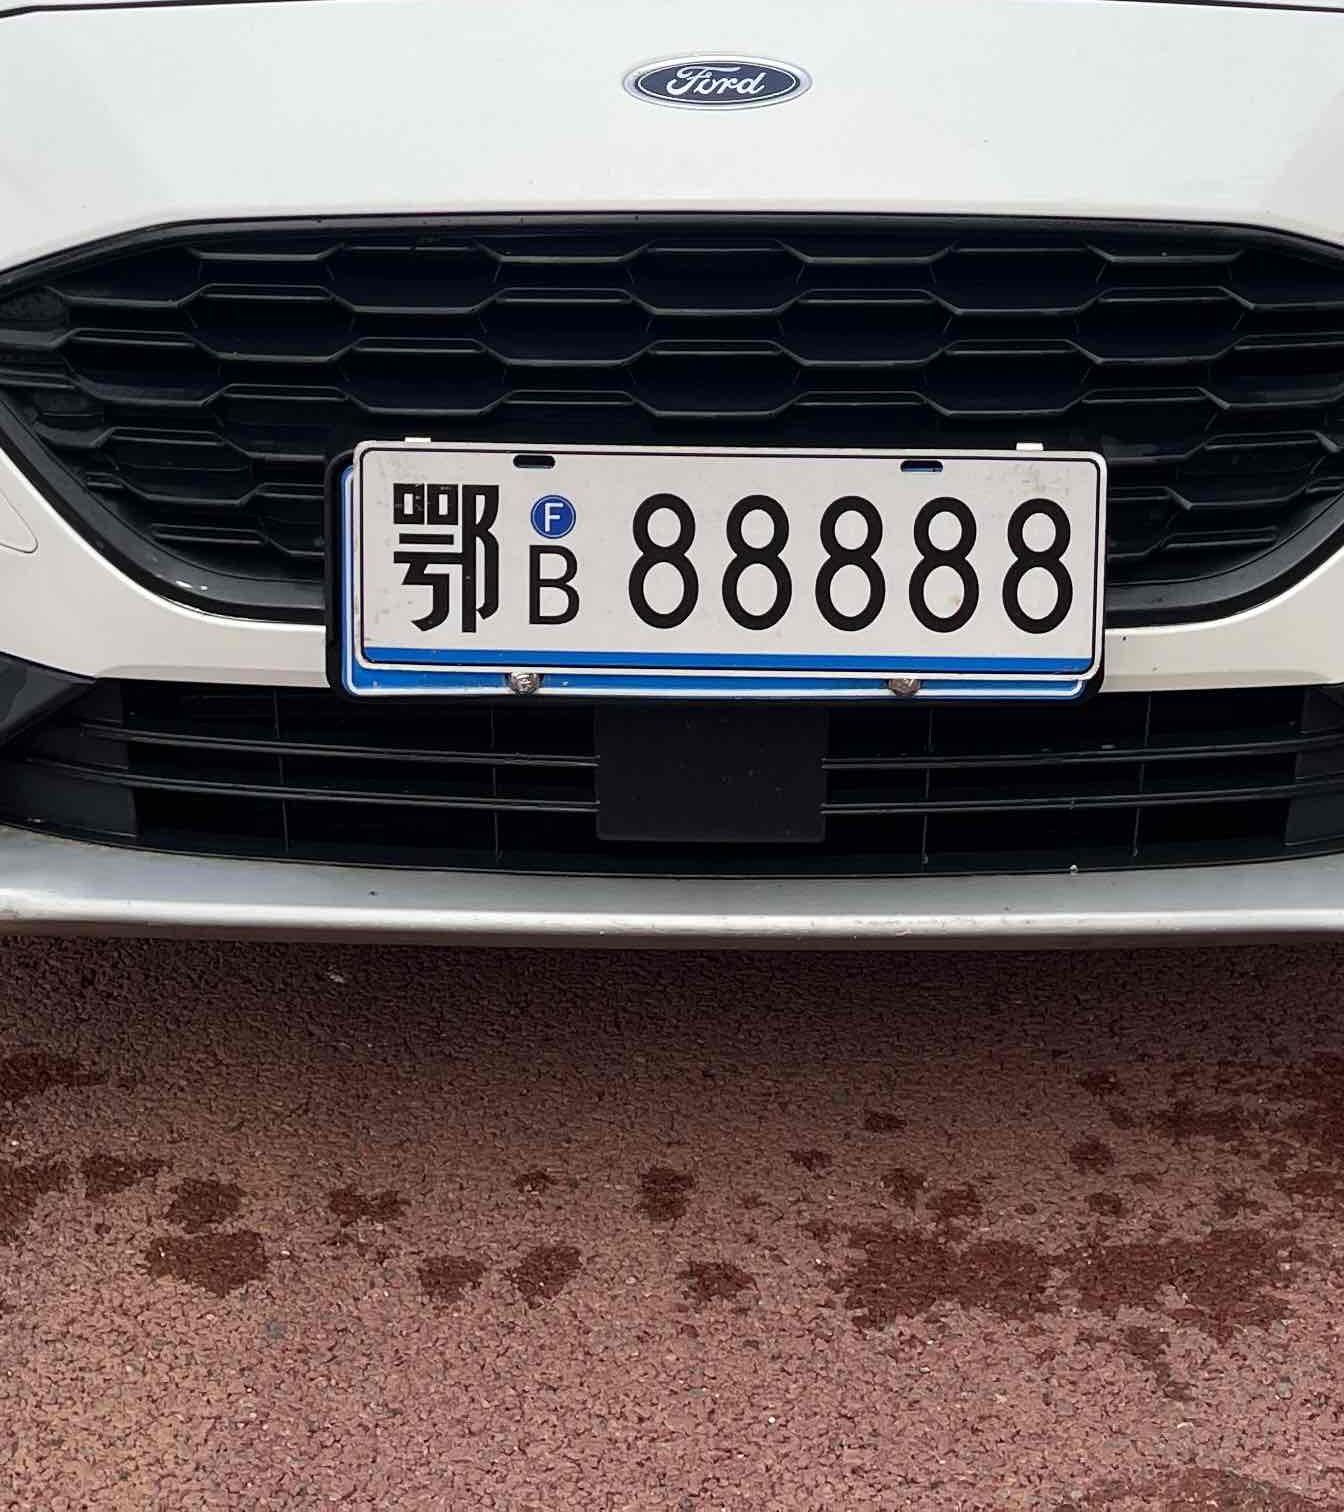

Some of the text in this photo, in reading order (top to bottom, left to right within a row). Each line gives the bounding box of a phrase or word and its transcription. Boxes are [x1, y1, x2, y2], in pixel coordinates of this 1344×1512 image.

[666, 65, 766, 96] Ford
[393, 482, 1073, 635] 鄂 B 88888
